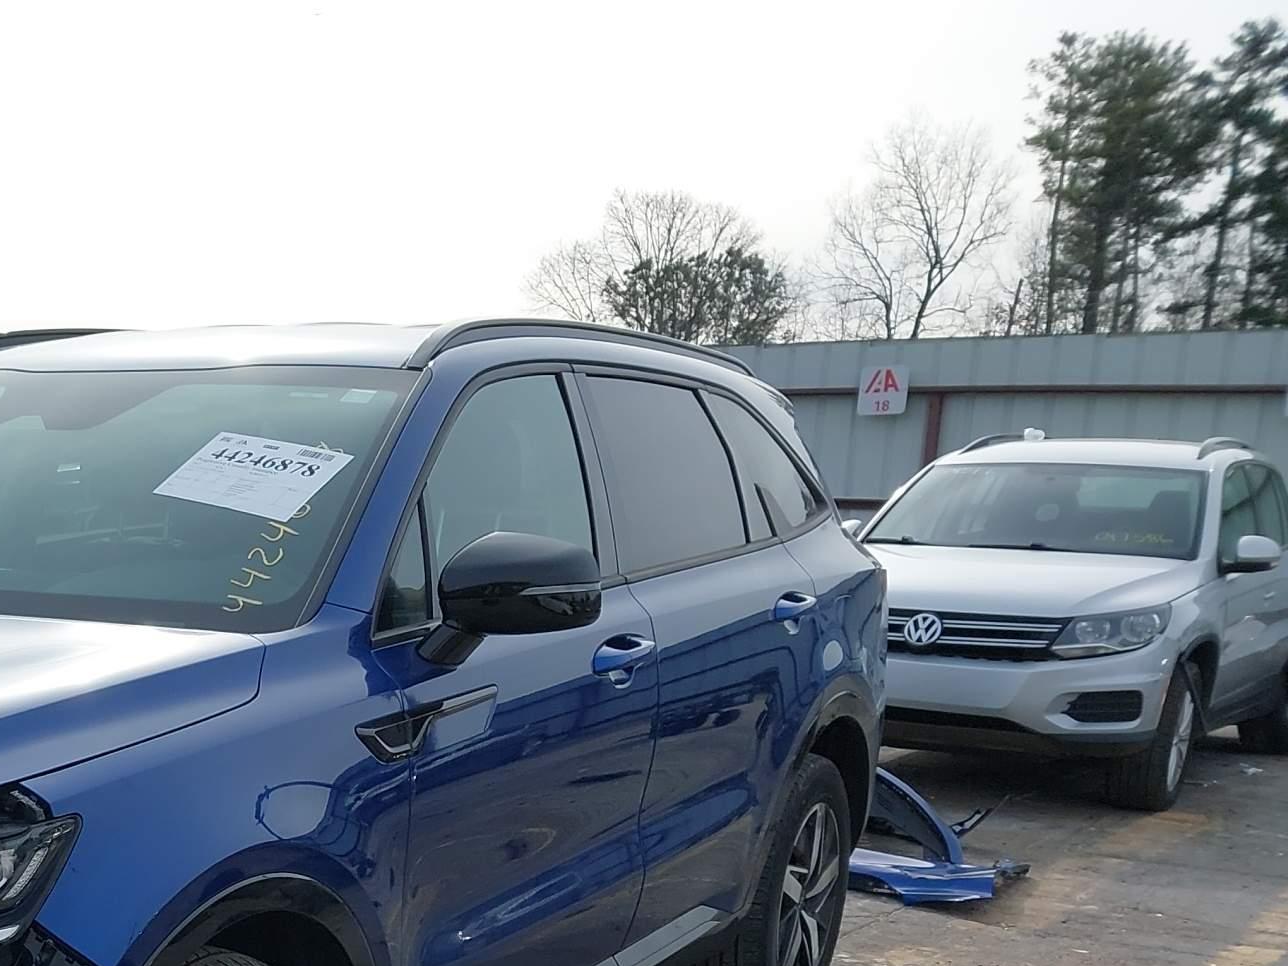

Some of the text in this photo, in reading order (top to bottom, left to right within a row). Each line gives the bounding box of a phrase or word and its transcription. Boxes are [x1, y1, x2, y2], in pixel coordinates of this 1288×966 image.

[874, 400, 890, 412] 18
[210, 447, 321, 477] 44246878
[904, 613, 942, 646] VW
